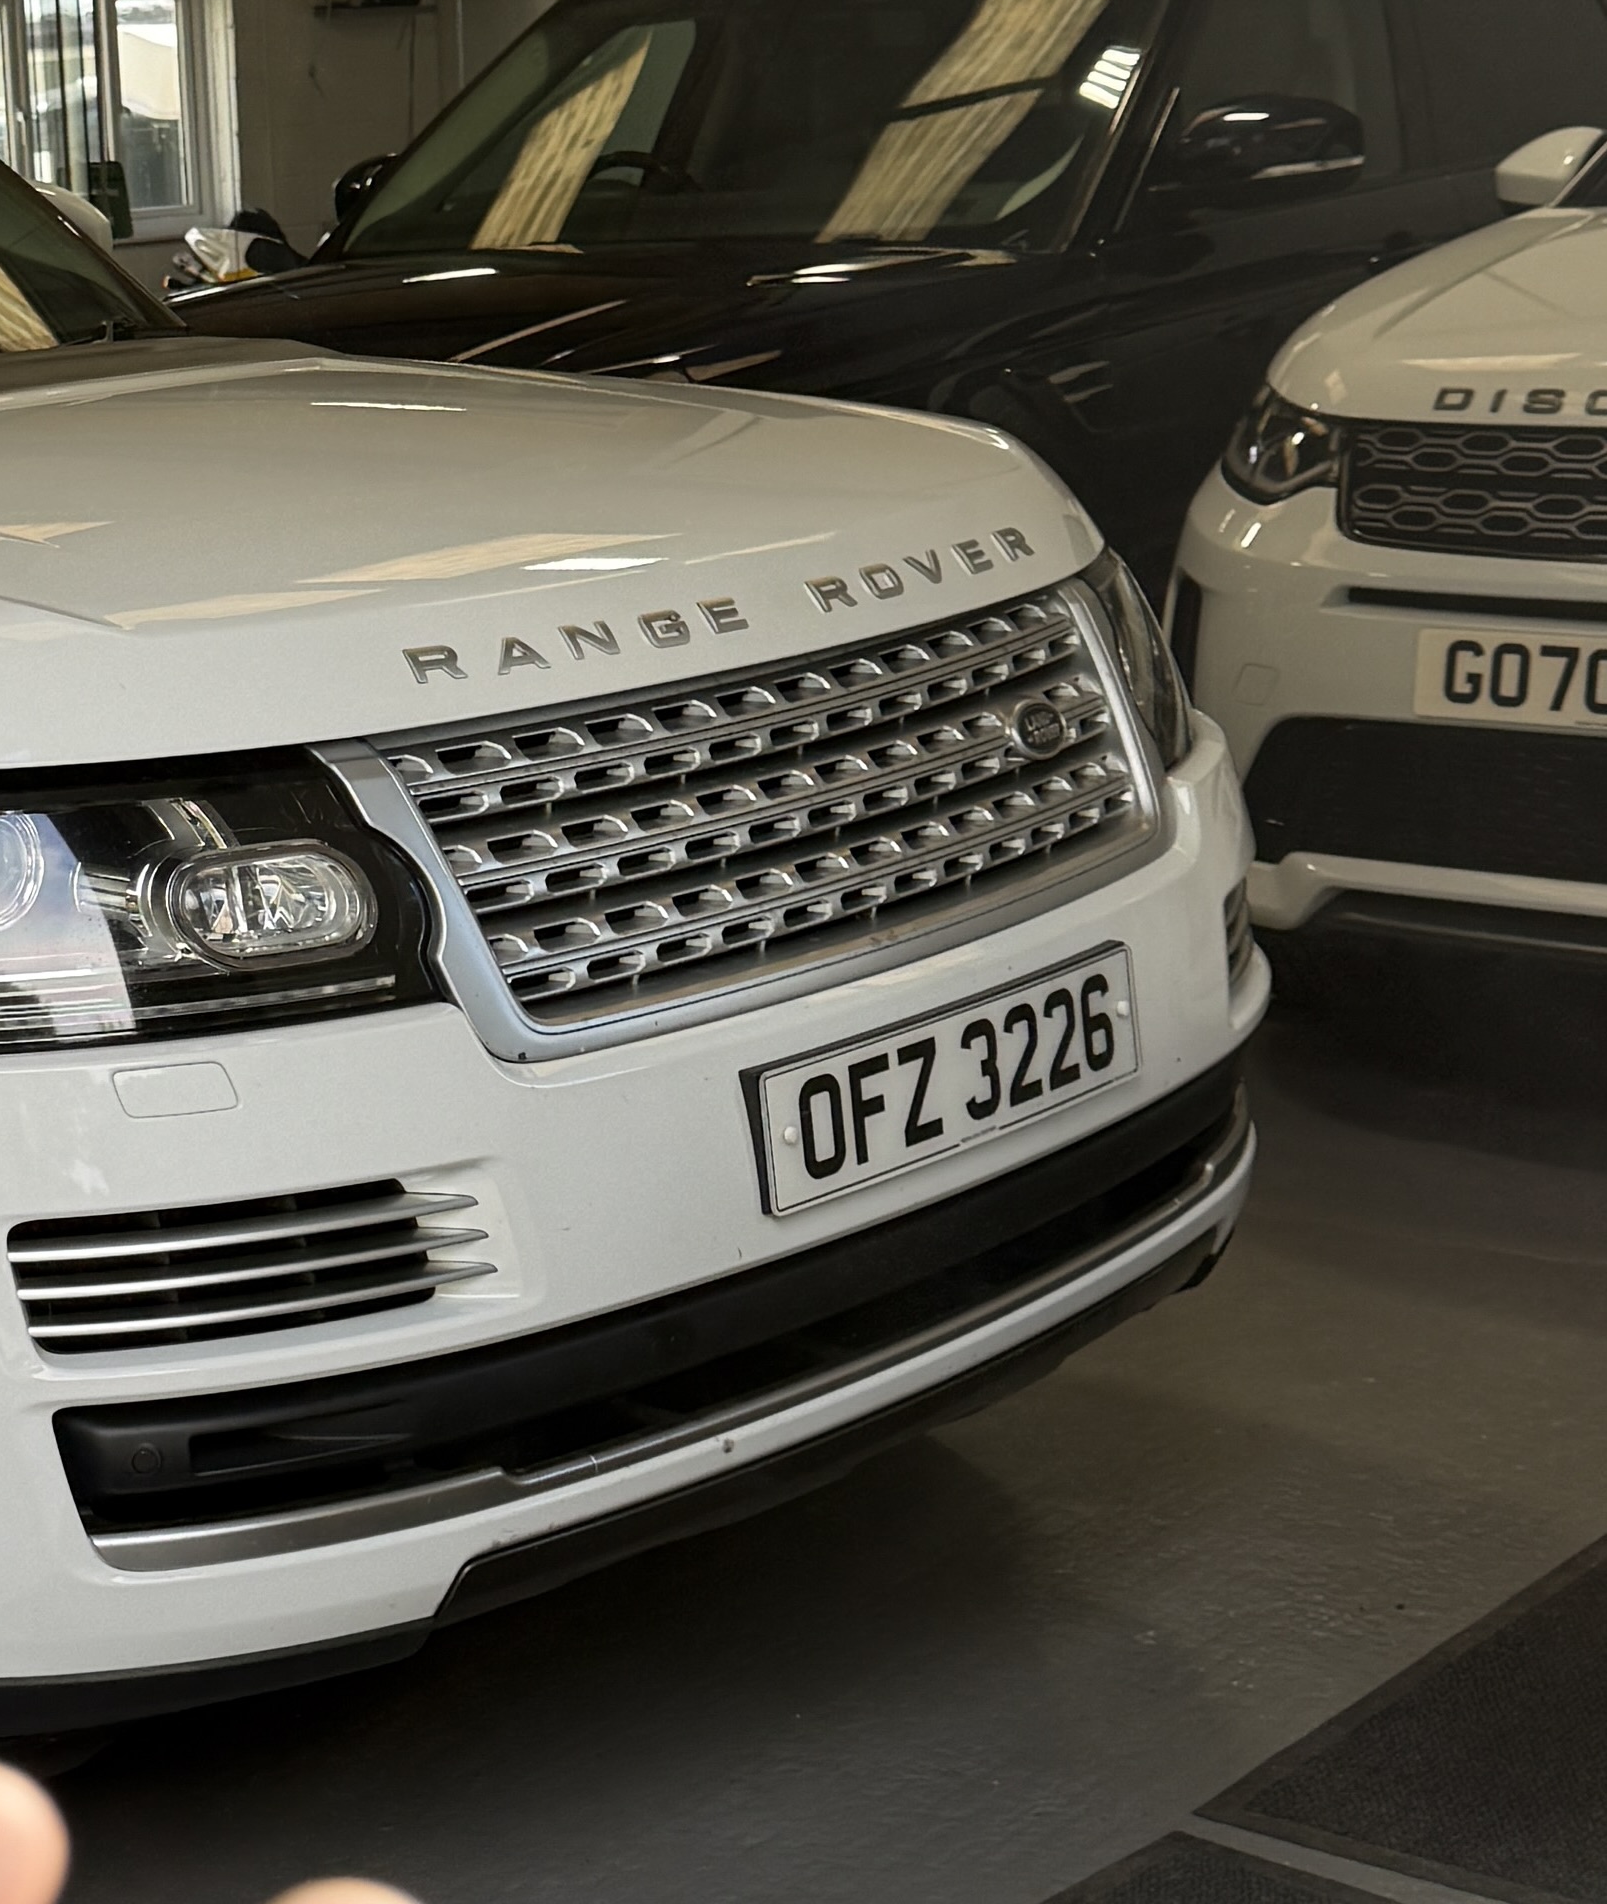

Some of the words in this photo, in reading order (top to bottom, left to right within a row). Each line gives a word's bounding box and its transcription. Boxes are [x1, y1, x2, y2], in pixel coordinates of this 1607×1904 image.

[402, 597, 749, 684] RANGE
[804, 527, 1036, 613] ROVER
[798, 1036, 944, 1179] OFZ
[960, 973, 1115, 1121] 3226
